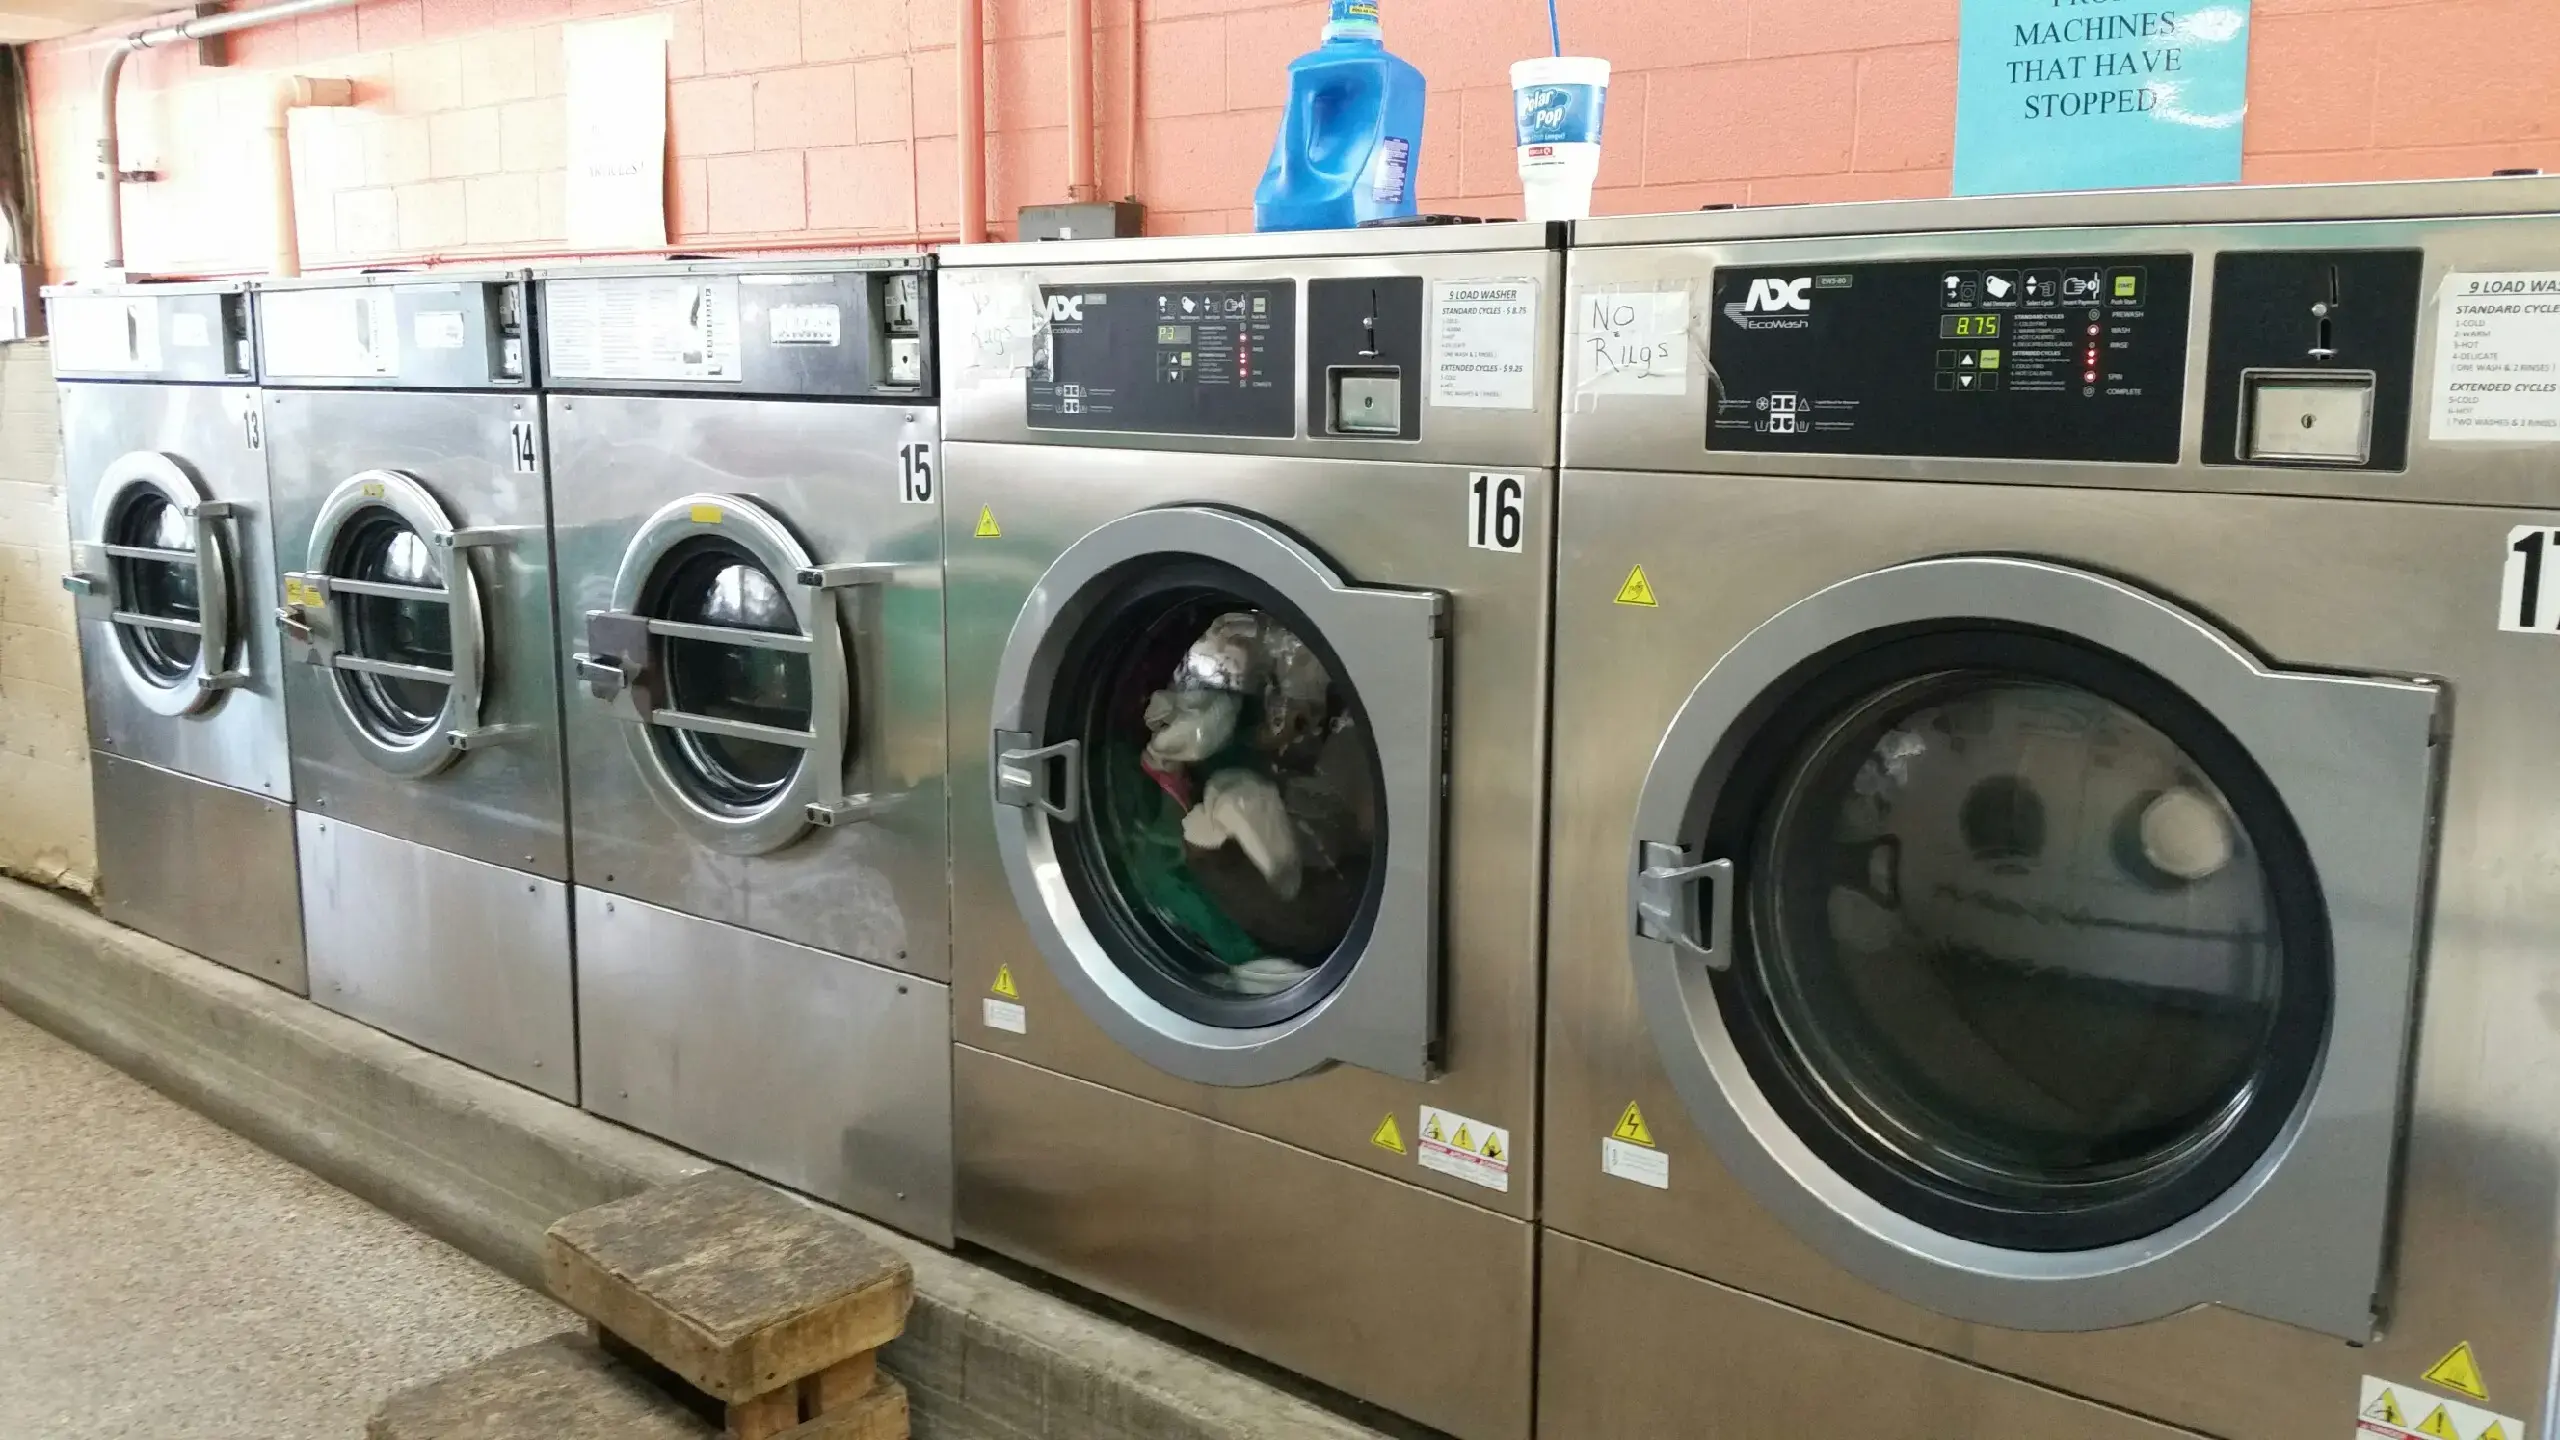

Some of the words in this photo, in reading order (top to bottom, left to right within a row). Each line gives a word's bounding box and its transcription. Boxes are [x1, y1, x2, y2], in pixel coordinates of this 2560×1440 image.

[2014, 11, 2175, 46] MACHINES
[2006, 55, 2087, 84] THAT
[2094, 48, 2182, 77] HAVE
[2024, 88, 2158, 119] STOPPED
[1535, 107, 1563, 129] Pop
[1455, 291, 1479, 300] LOAD
[1480, 290, 1517, 300] WASHER
[1744, 278, 1812, 311] ADC
[2469, 281, 2479, 293] 9
[2483, 281, 2525, 293] LOAD
[2531, 280, 2560, 292] WA
[1047, 295, 1083, 321] ADC
[1442, 307, 1477, 315] STANDARD
[1479, 307, 1501, 315] CYCLES
[1593, 296, 1634, 331] NO
[2456, 305, 2521, 314] STANDARD
[1160, 327, 1174, 340] P3
[1748, 319, 1809, 329] EcoWash
[1440, 364, 1474, 372] EXTENDED
[1587, 338, 1668, 379] Rugs
[2452, 352, 2498, 361] 4-DELICATE
[2449, 383, 2511, 392] EXTENDED
[2515, 383, 2556, 392] CYCLES
[243, 410, 260, 449] 13
[512, 424, 536, 472] 14
[900, 444, 932, 502] 15
[1474, 476, 1522, 548] 16
